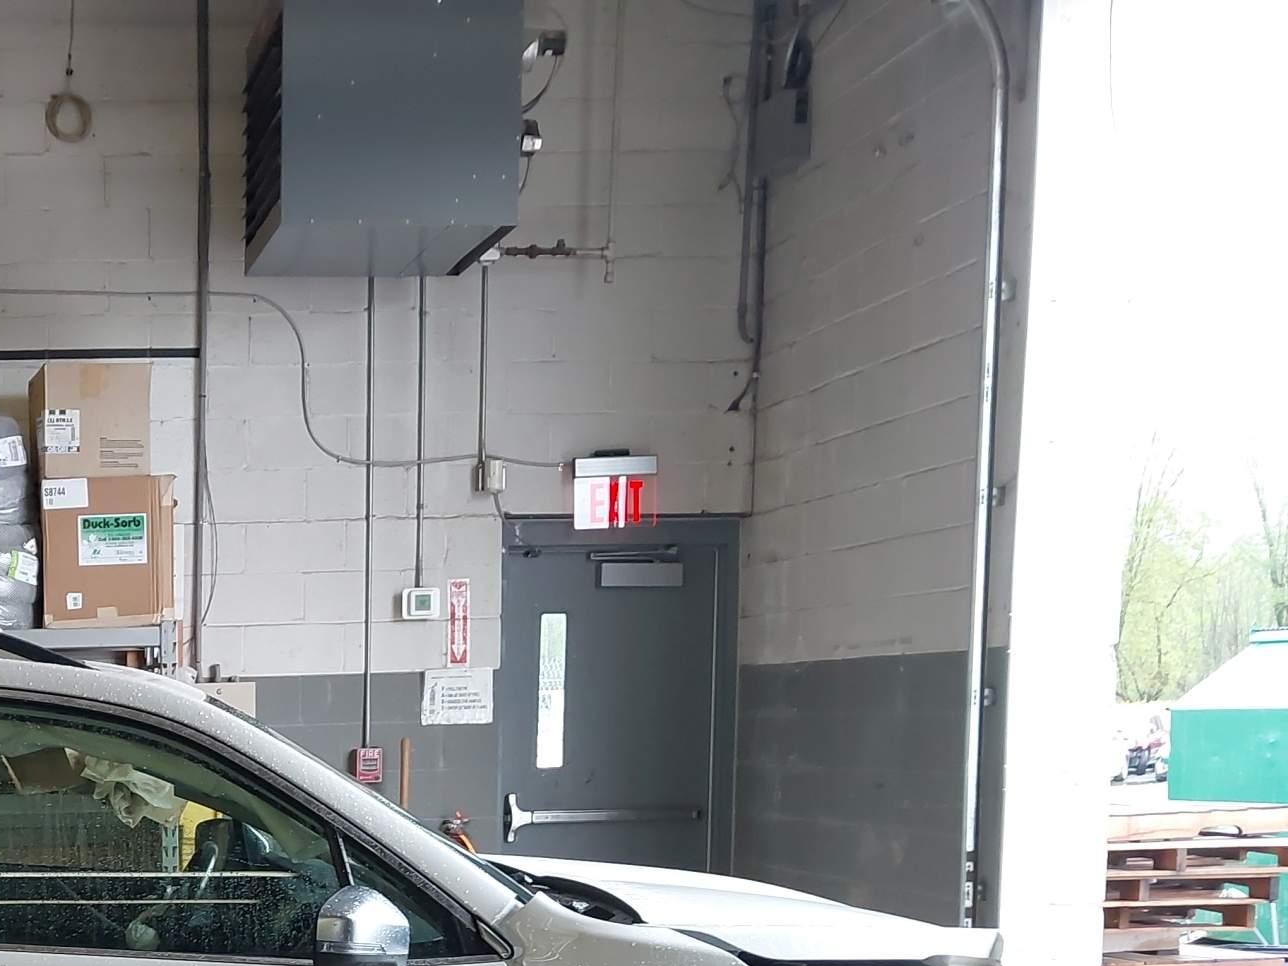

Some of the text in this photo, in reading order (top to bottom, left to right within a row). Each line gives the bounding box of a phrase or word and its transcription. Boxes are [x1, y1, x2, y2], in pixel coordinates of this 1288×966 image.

[589, 480, 644, 523] EXIT
[82, 516, 142, 530] Duck-Sorb
[360, 749, 381, 758] FIRE
